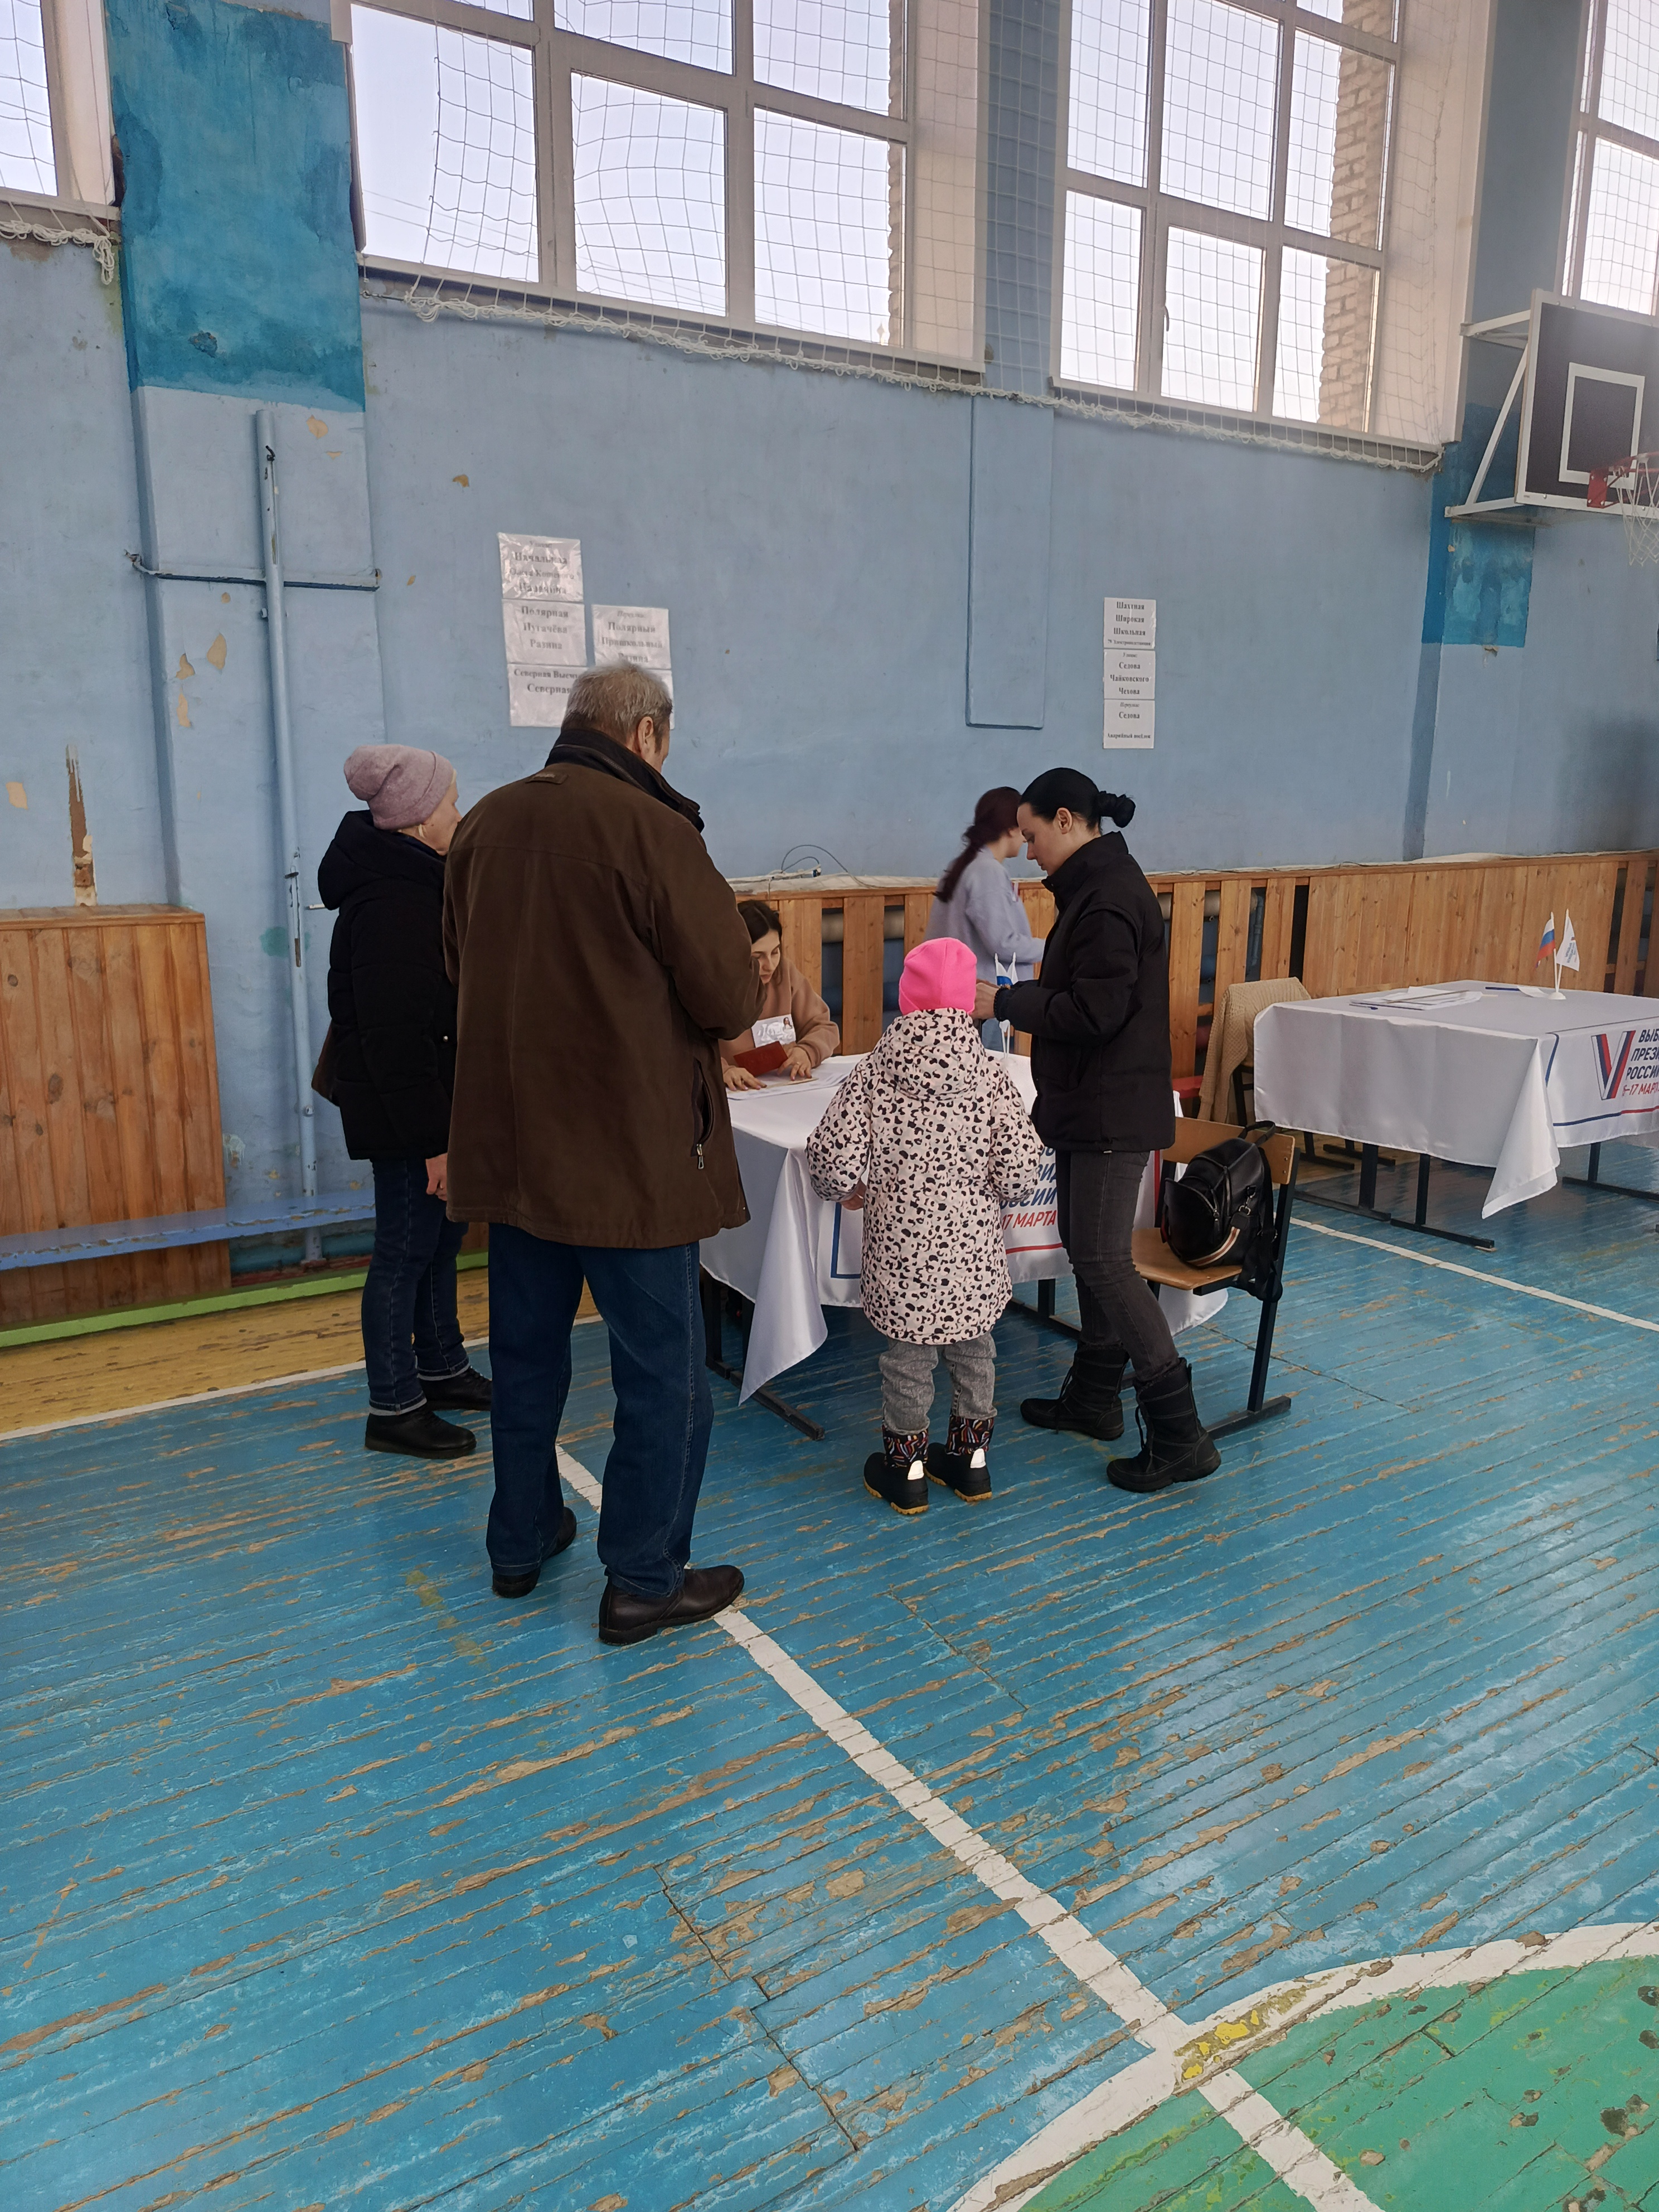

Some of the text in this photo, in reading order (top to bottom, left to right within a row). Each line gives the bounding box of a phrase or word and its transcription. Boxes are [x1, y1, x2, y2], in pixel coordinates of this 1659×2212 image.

[521, 605, 569, 618] Полярная
[1115, 614, 1144, 624] Широкая
[608, 622, 656, 634] Полярный
[1114, 627, 1146, 636] Школьная
[530, 639, 563, 649] Разина
[514, 668, 551, 679] Северная
[1110, 674, 1149, 682] Чайковского
[1638, 1029, 1659, 1042] ВЫБ
[1013, 1210, 1057, 1229] МАРТА
